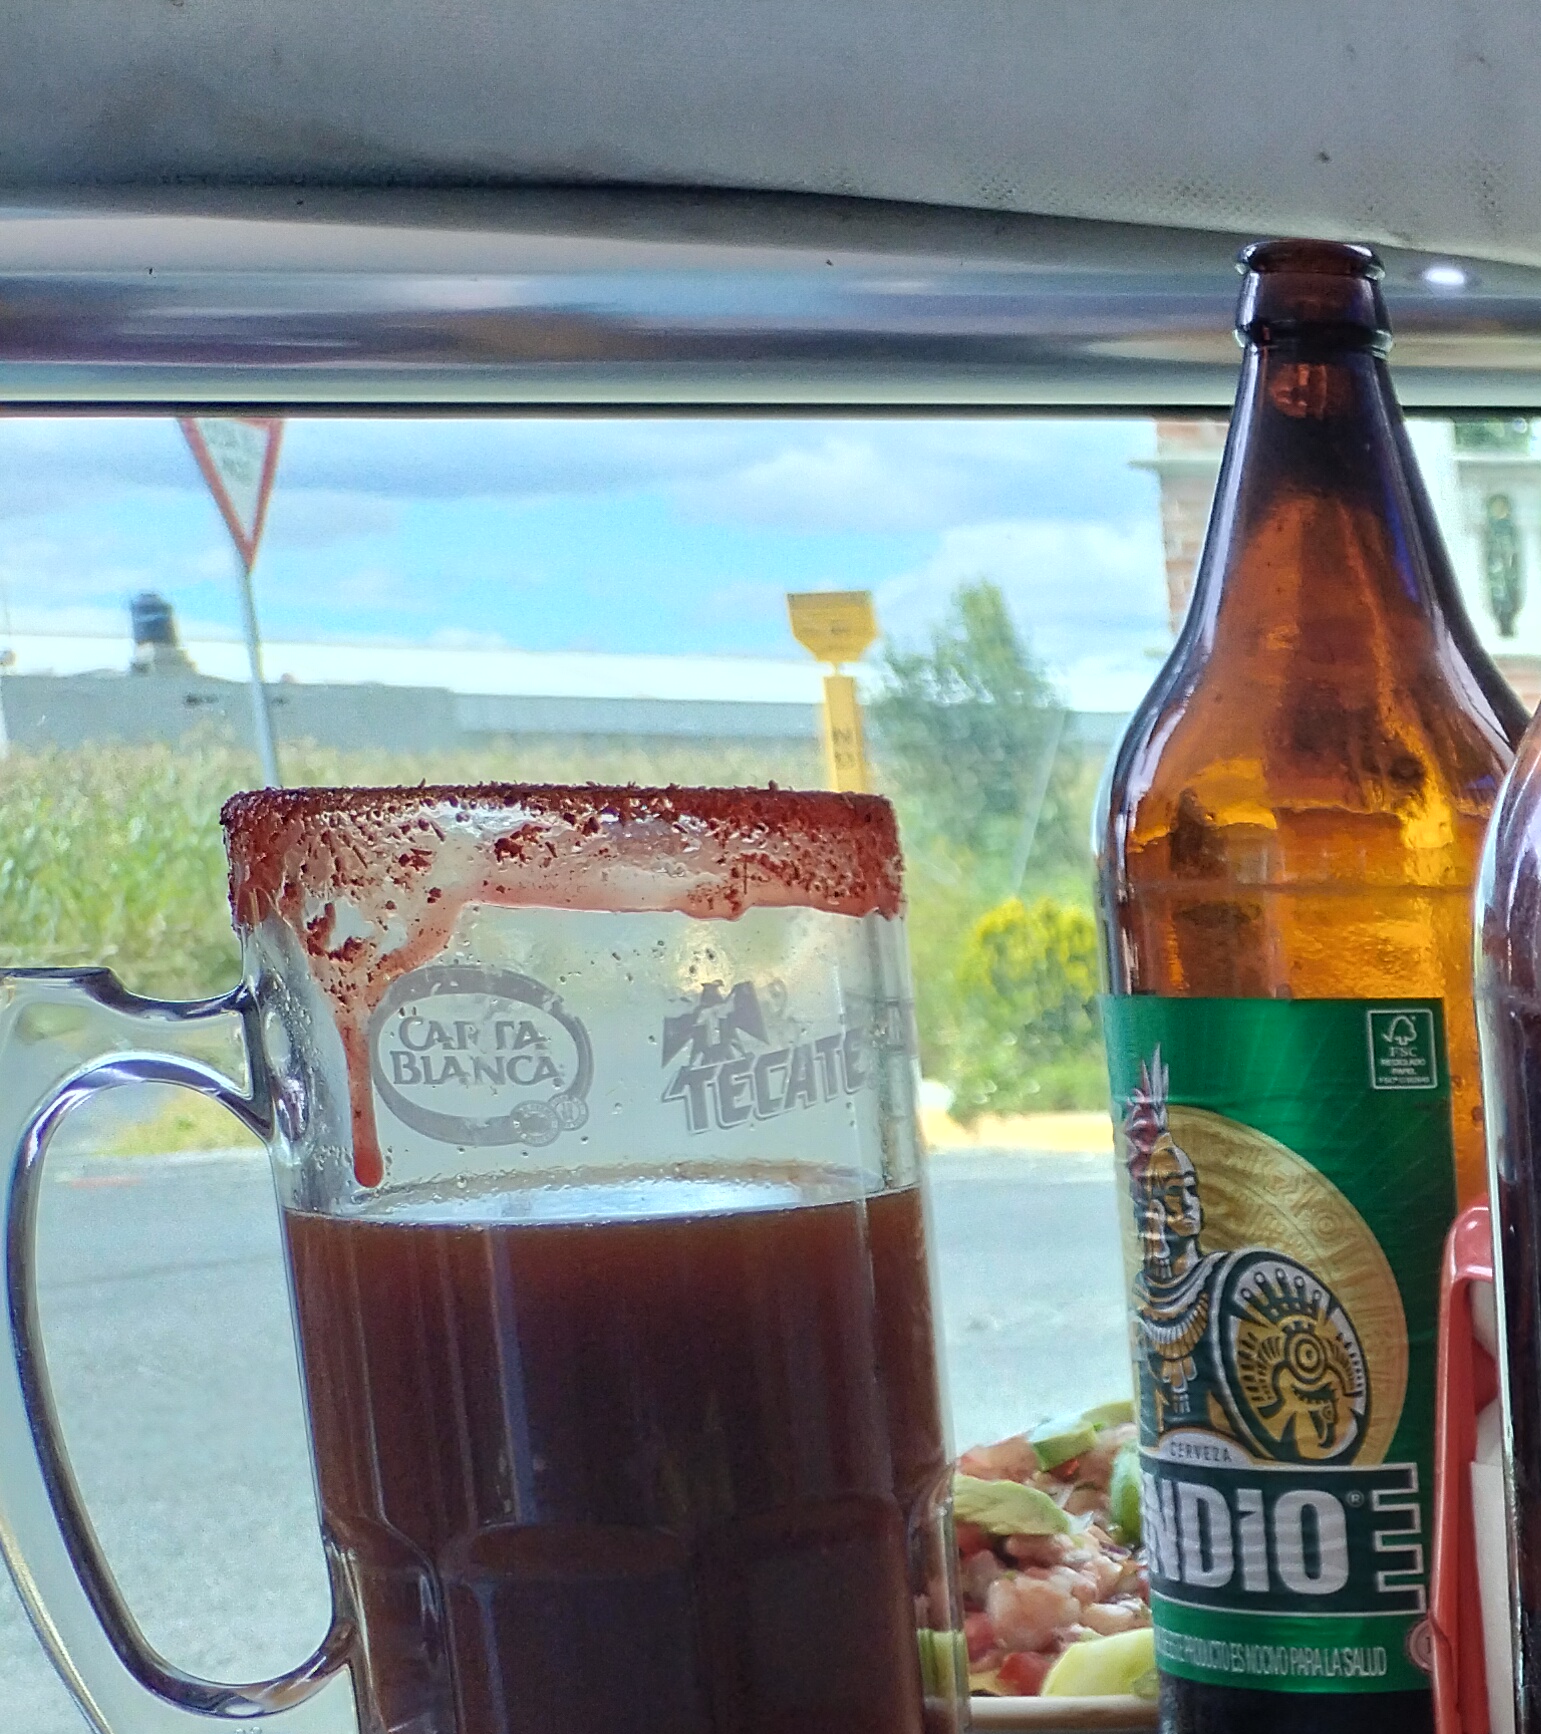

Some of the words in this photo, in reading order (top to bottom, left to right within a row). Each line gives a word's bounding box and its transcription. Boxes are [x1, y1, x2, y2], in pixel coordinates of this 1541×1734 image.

[399, 1016, 551, 1051] CARTA
[389, 1050, 561, 1086] BLANCA
[1388, 1046, 1418, 1058] FSC
[661, 1028, 870, 1135] TECATE
[1170, 1440, 1233, 1464] CERVEZA
[1141, 1468, 1350, 1595] NDIO
[1230, 1642, 1245, 1673] ES
[1290, 1646, 1323, 1677] PARA
[1325, 1647, 1341, 1677] LA
[1341, 1646, 1387, 1677] SALUD
